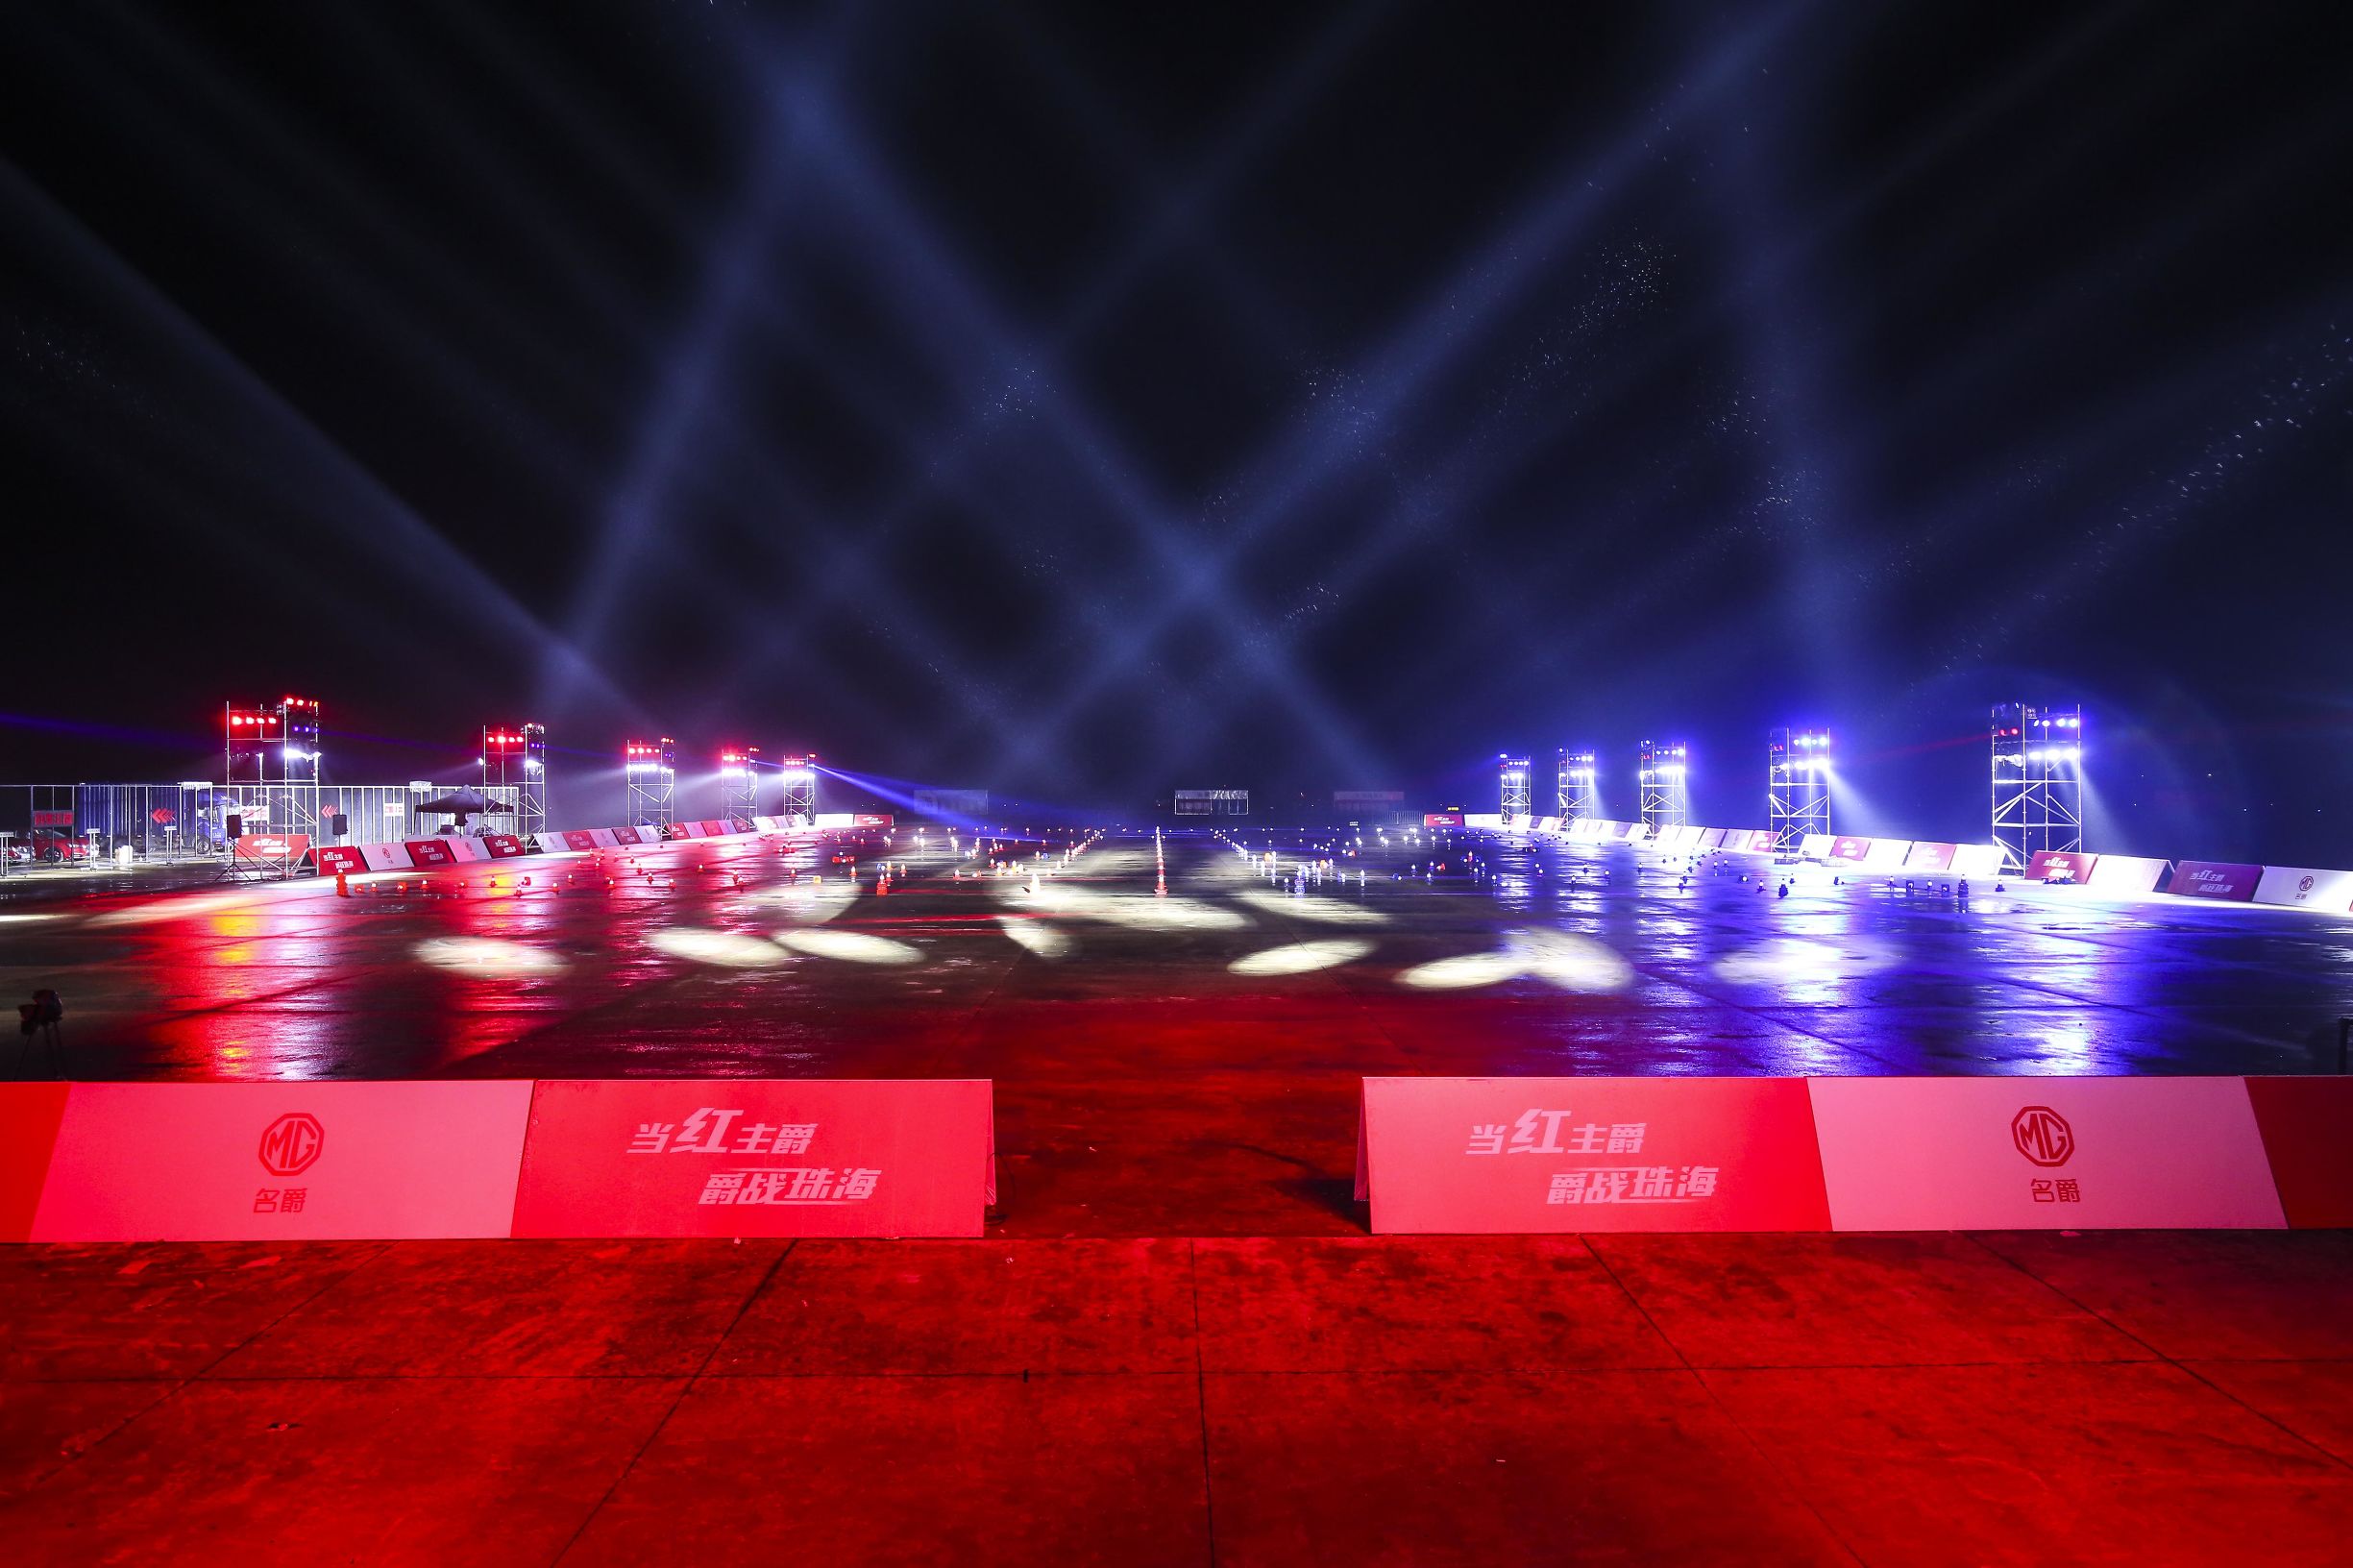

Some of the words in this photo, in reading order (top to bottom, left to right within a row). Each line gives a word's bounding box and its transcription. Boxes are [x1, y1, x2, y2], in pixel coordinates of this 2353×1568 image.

[266, 1120, 318, 1169] MG
[626, 1107, 819, 1154] 当红主爵
[1465, 1108, 1647, 1155] 当红主爵
[2019, 1113, 2068, 1160] MG
[253, 1188, 308, 1213] 名爵
[698, 1166, 882, 1206] 爵战珠海
[1546, 1165, 1720, 1205] 爵战珠海
[2030, 1178, 2080, 1203] 名爵
